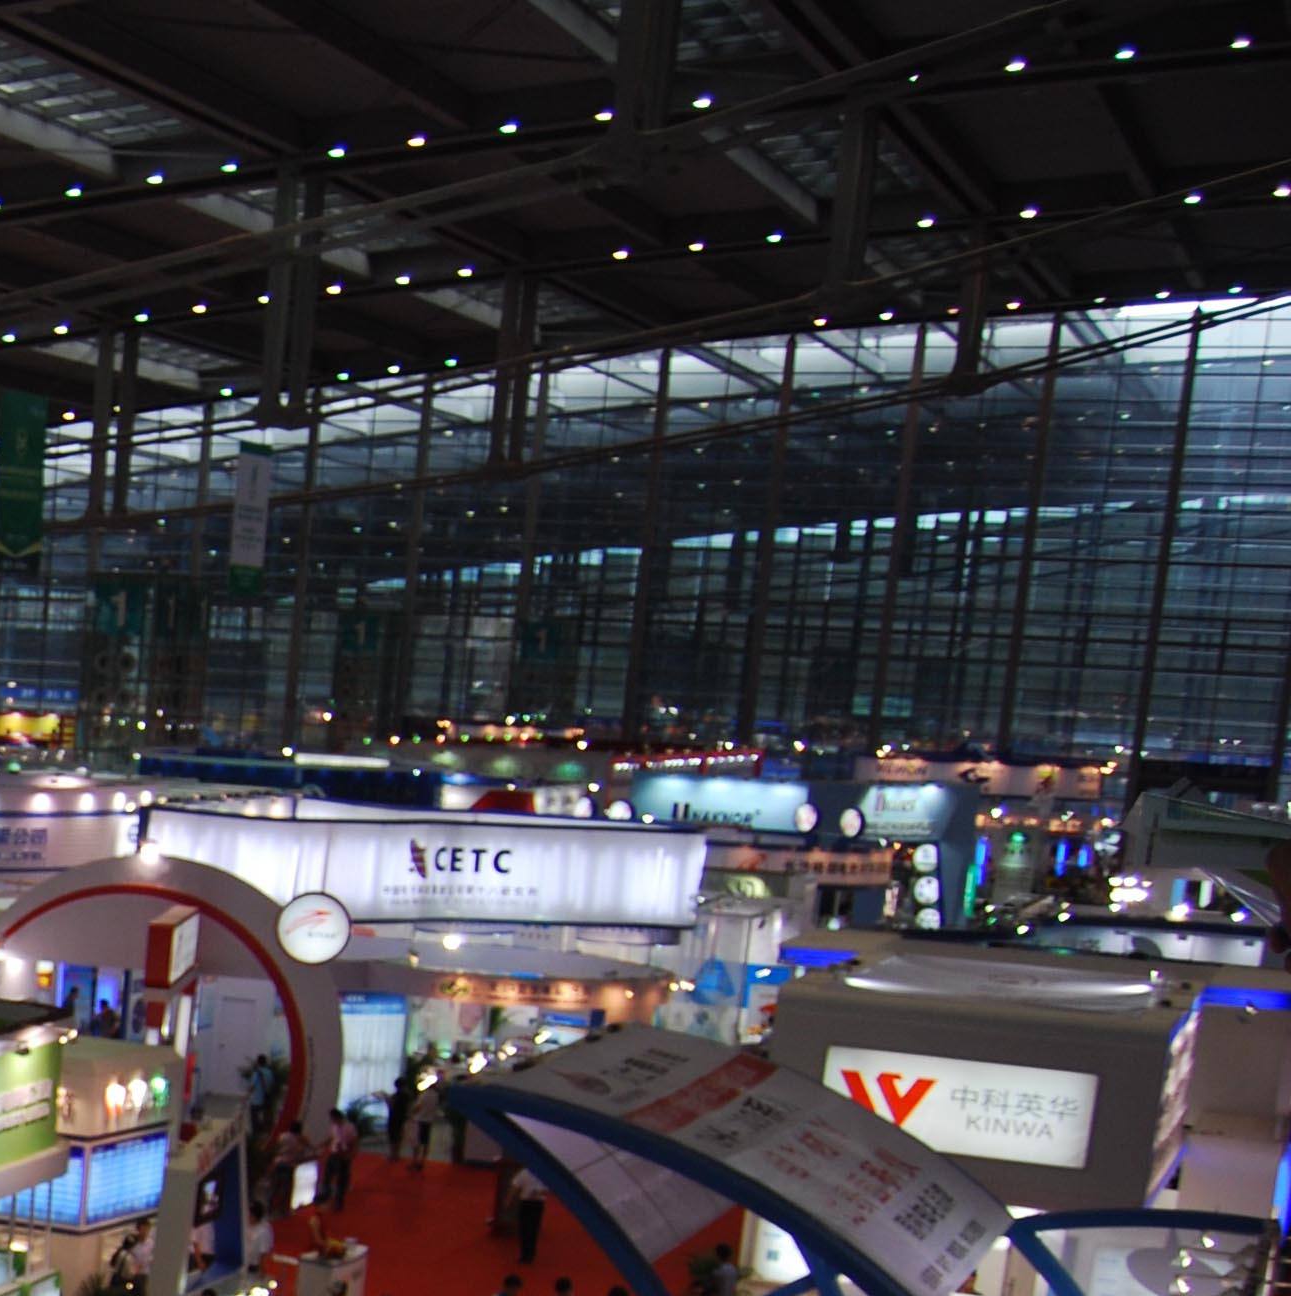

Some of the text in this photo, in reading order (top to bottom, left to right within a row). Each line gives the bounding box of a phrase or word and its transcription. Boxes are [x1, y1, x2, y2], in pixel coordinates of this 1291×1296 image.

[435, 846, 512, 874] CETC
[951, 1085, 1081, 1122] 中科英华
[966, 1113, 1055, 1141] KINWA
